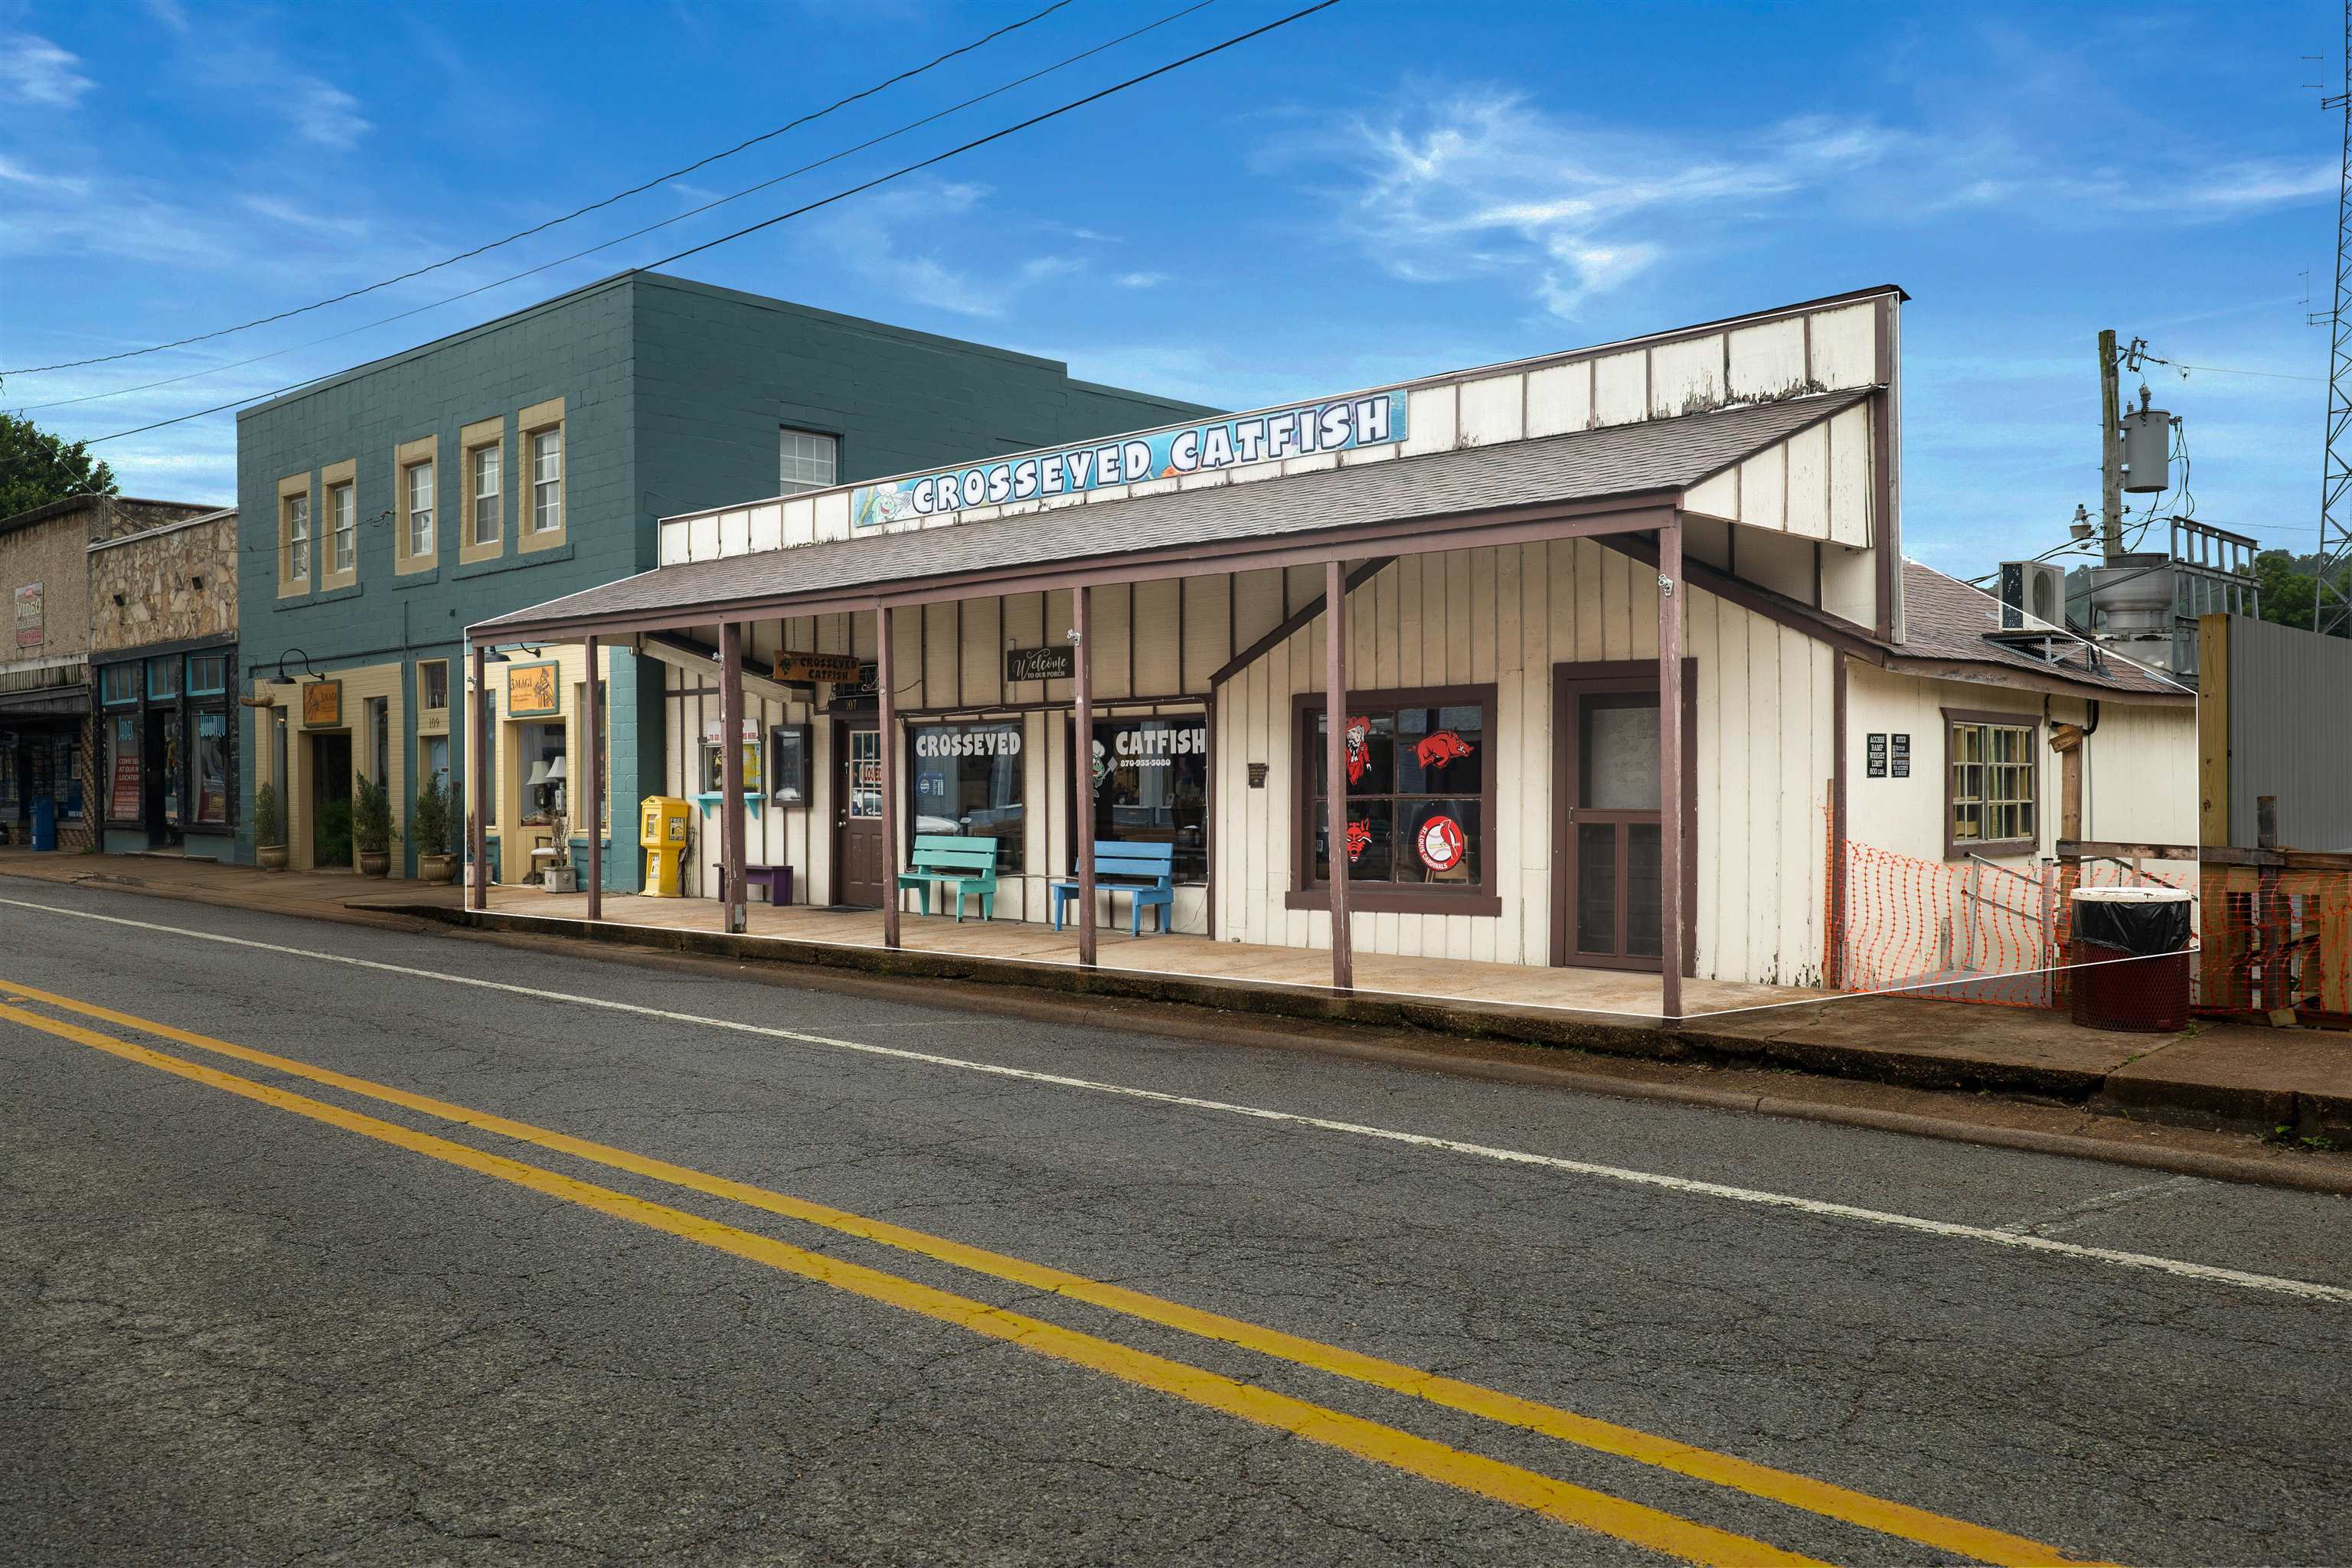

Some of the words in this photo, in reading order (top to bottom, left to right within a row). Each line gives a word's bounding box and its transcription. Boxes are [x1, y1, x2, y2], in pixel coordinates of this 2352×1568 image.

[912, 439, 1152, 514] CROSSEYED
[1170, 395, 1390, 472] CATFISH
[17, 597, 41, 618] VIDEO
[800, 657, 857, 670] CROSSEYED
[1012, 648, 1068, 680] Welcome
[808, 669, 848, 681] CATFISH
[846, 699, 857, 710] 107
[429, 717, 440, 729] 109
[916, 732, 1021, 757] CROSSEYED
[1116, 728, 1206, 756] CATFISH
[1120, 759, 1171, 767] 870-955-5080
[861, 767, 882, 782] LOSE
[1422, 853, 1448, 870] CARDINALS
